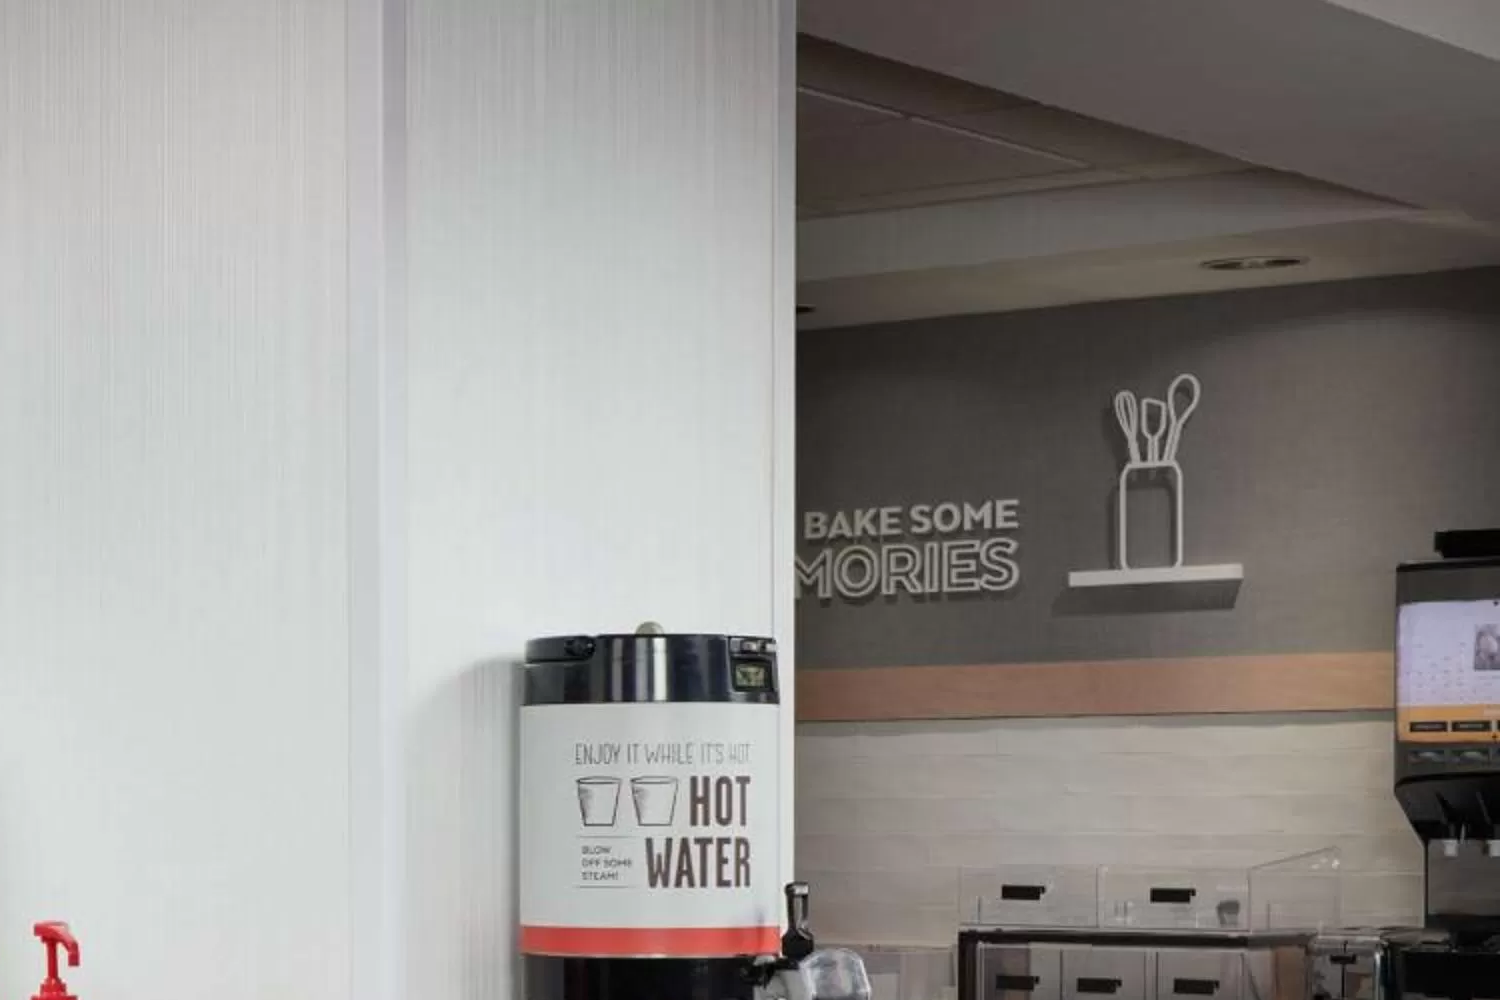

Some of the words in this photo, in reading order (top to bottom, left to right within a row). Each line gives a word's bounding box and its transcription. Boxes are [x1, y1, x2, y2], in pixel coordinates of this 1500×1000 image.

[803, 507, 903, 540] BAKE
[909, 499, 1020, 534] SOME
[795, 536, 1020, 598] MORIES
[575, 743, 621, 765] ENJOY
[627, 743, 641, 765] IT
[644, 742, 693, 765] WHILE
[689, 775, 751, 826] HOT
[644, 836, 751, 889] WATER
